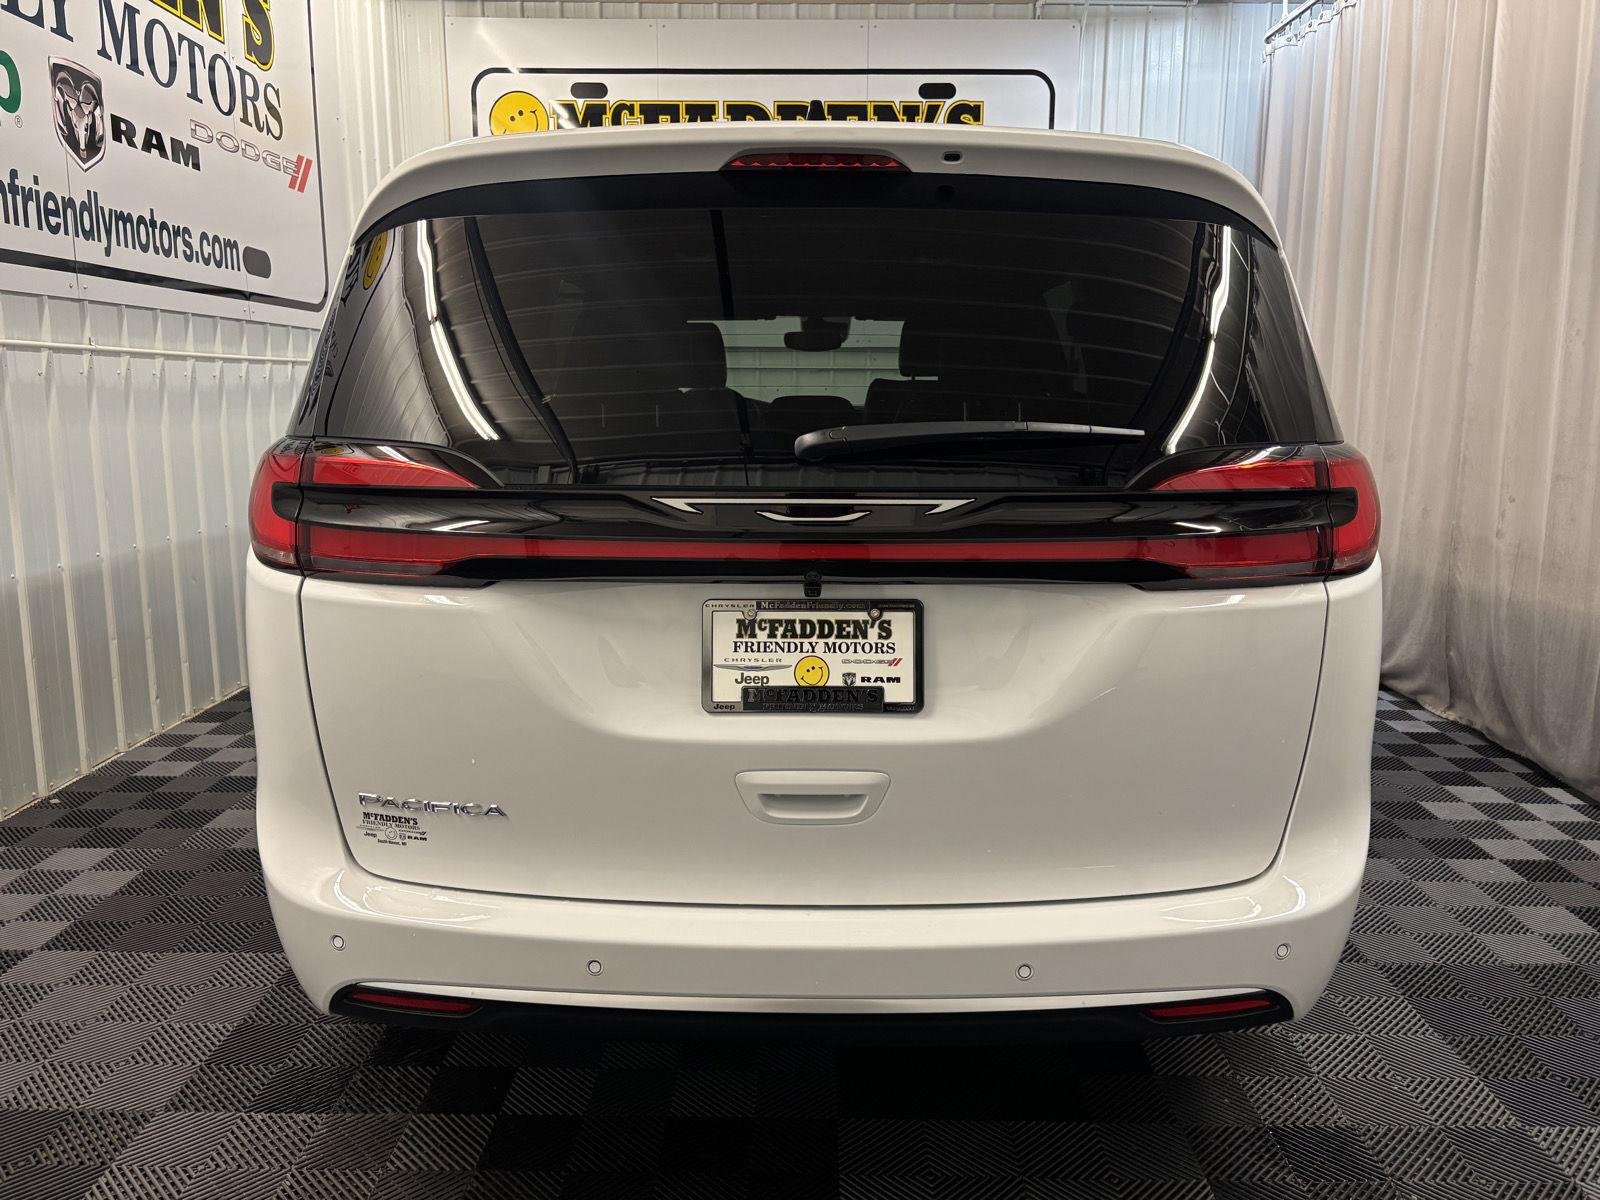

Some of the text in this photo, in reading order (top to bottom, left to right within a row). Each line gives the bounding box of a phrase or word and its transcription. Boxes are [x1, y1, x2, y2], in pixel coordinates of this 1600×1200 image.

[97, 0, 284, 141] MOTORS
[110, 113, 201, 172] RAM
[190, 119, 300, 177] DODGE
[732, 641, 896, 655] FRIENDLY MOTORS
[735, 673, 770, 686] Jeep
[358, 793, 507, 817] PACIFICA
[362, 819, 393, 828] FRIENDLY
